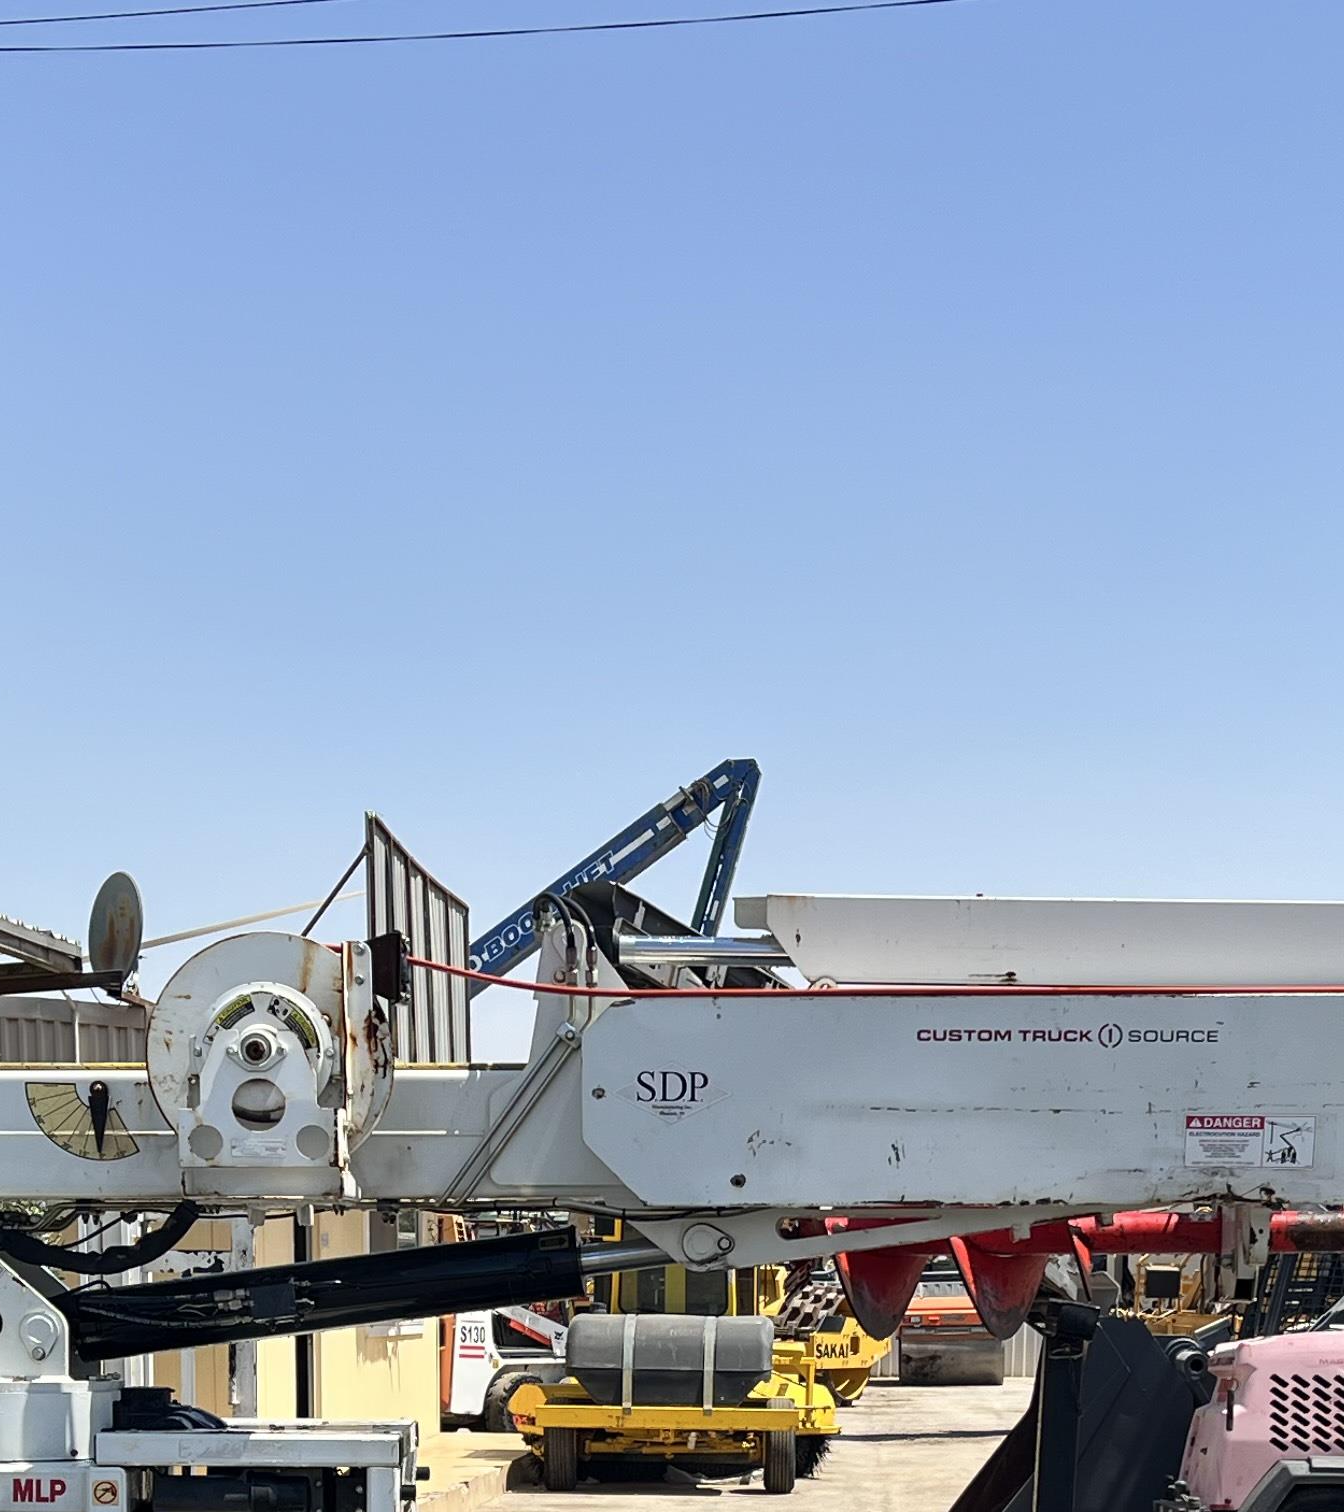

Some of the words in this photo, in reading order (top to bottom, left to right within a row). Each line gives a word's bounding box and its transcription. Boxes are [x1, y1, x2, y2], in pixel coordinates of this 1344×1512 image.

[916, 1029, 1012, 1043] CUSTOM
[1018, 1029, 1093, 1043] TRUCK
[1128, 1029, 1219, 1043] SOURCE
[1203, 1117, 1262, 1128] DANGER
[460, 1325, 486, 1344] S130
[815, 1343, 849, 1359] SAKAI
[13, 1478, 67, 1503] MLP
